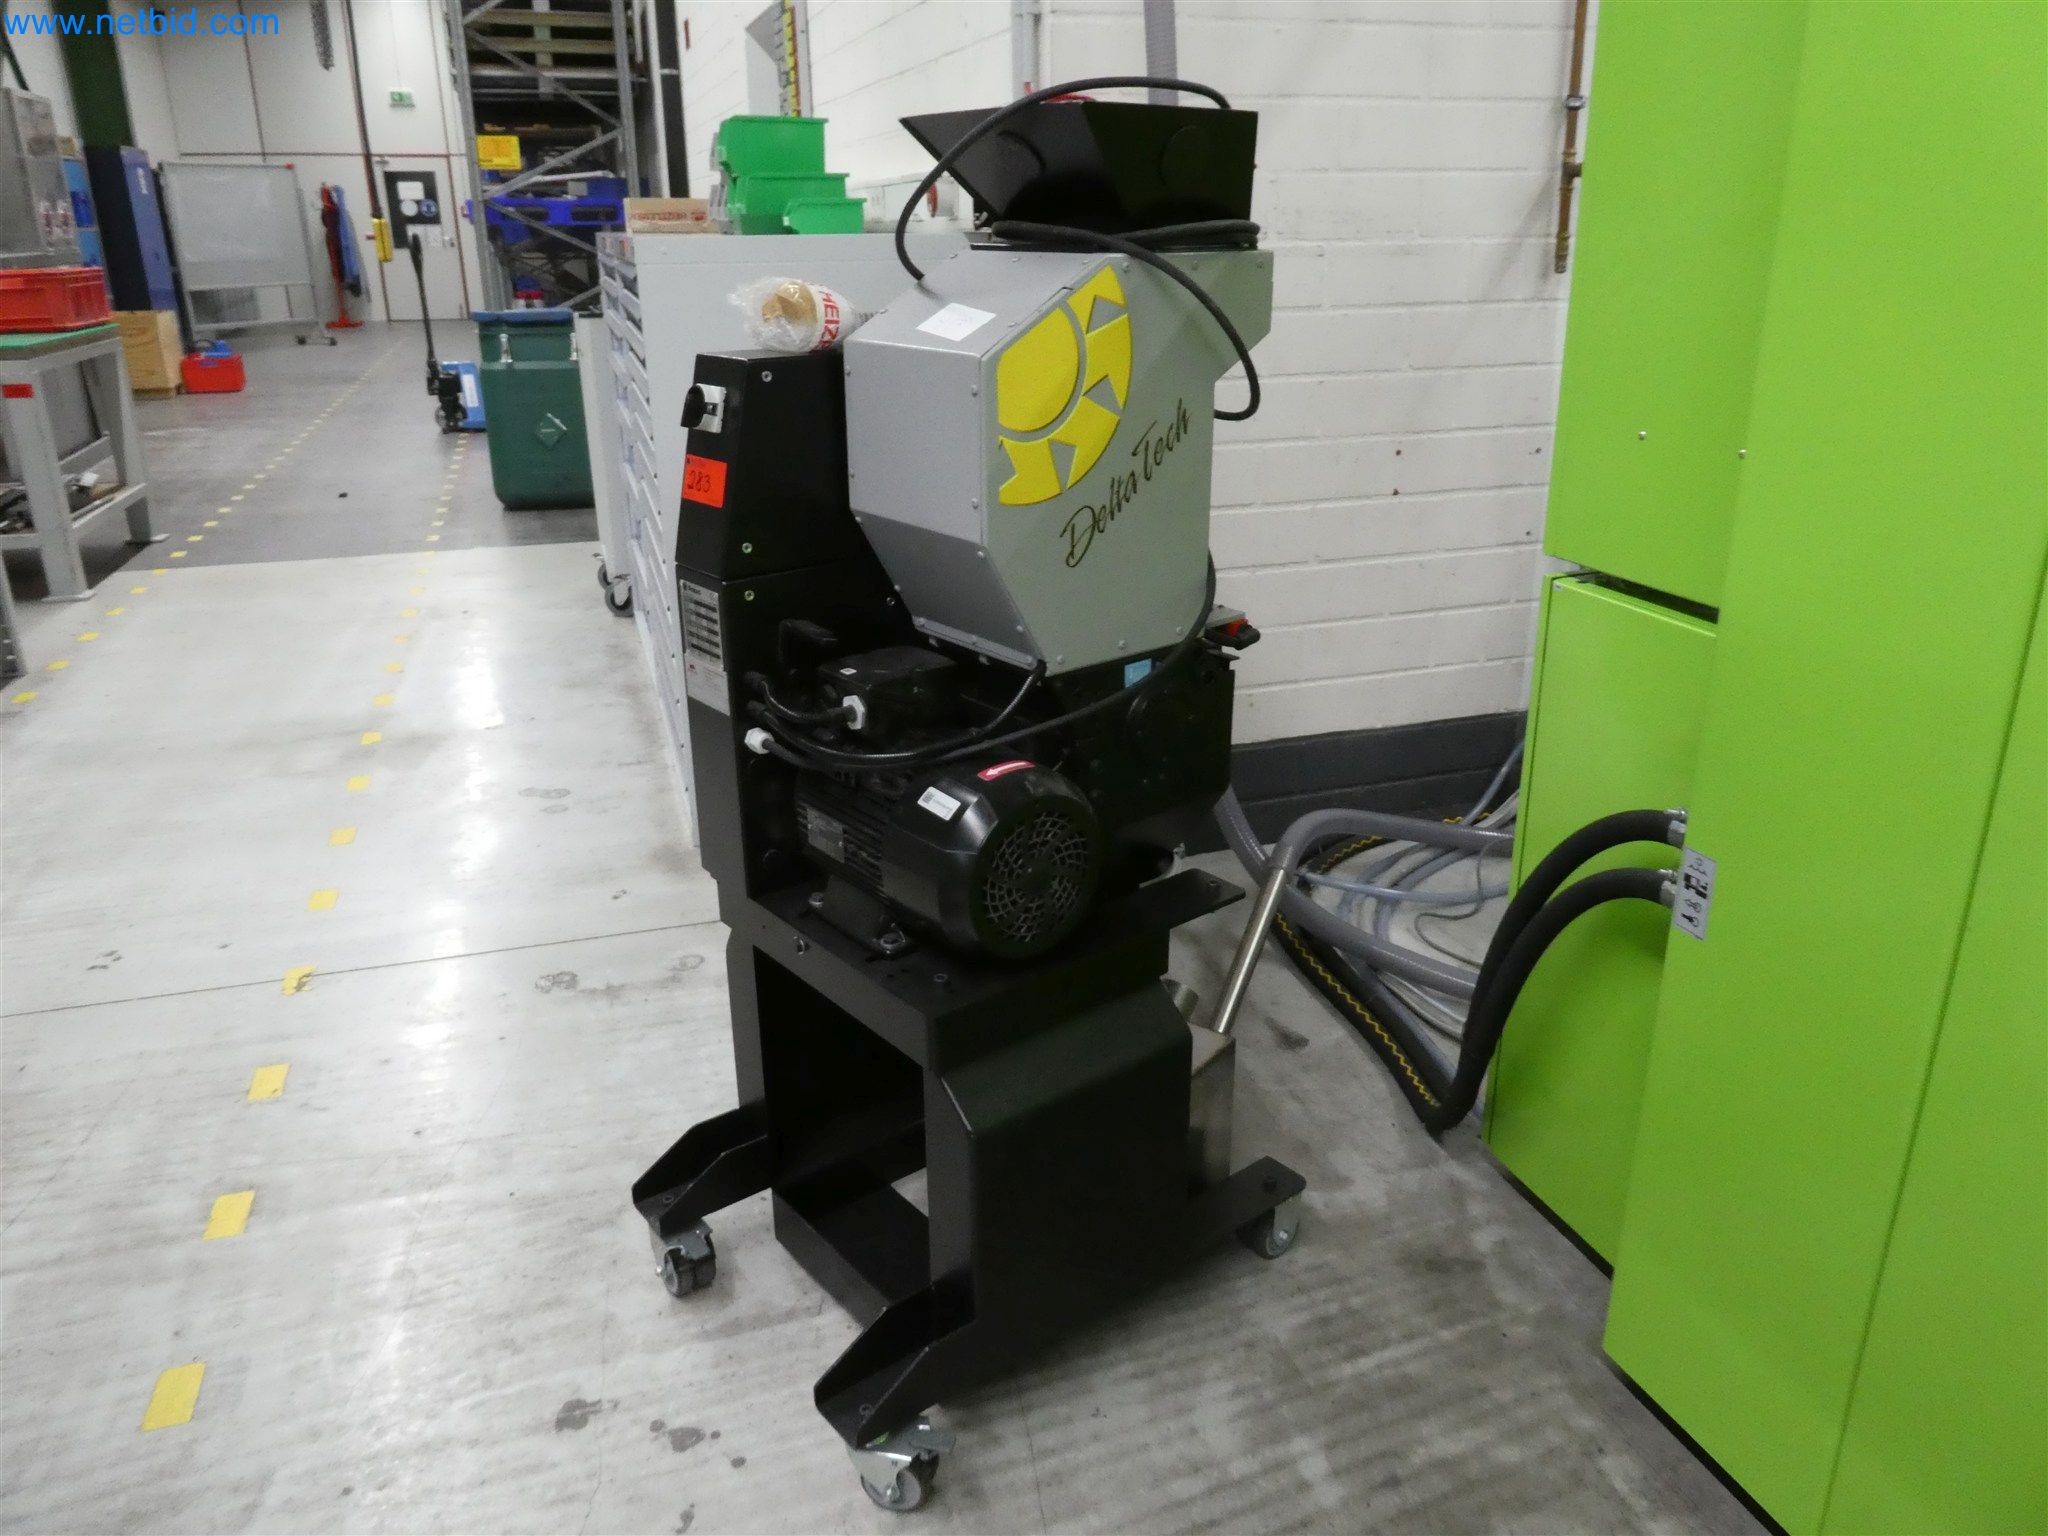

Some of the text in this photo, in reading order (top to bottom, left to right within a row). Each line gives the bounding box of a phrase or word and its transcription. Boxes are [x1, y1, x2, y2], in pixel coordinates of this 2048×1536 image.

[686, 469, 712, 493] 283
[1059, 397, 1191, 568] Delta Tech
